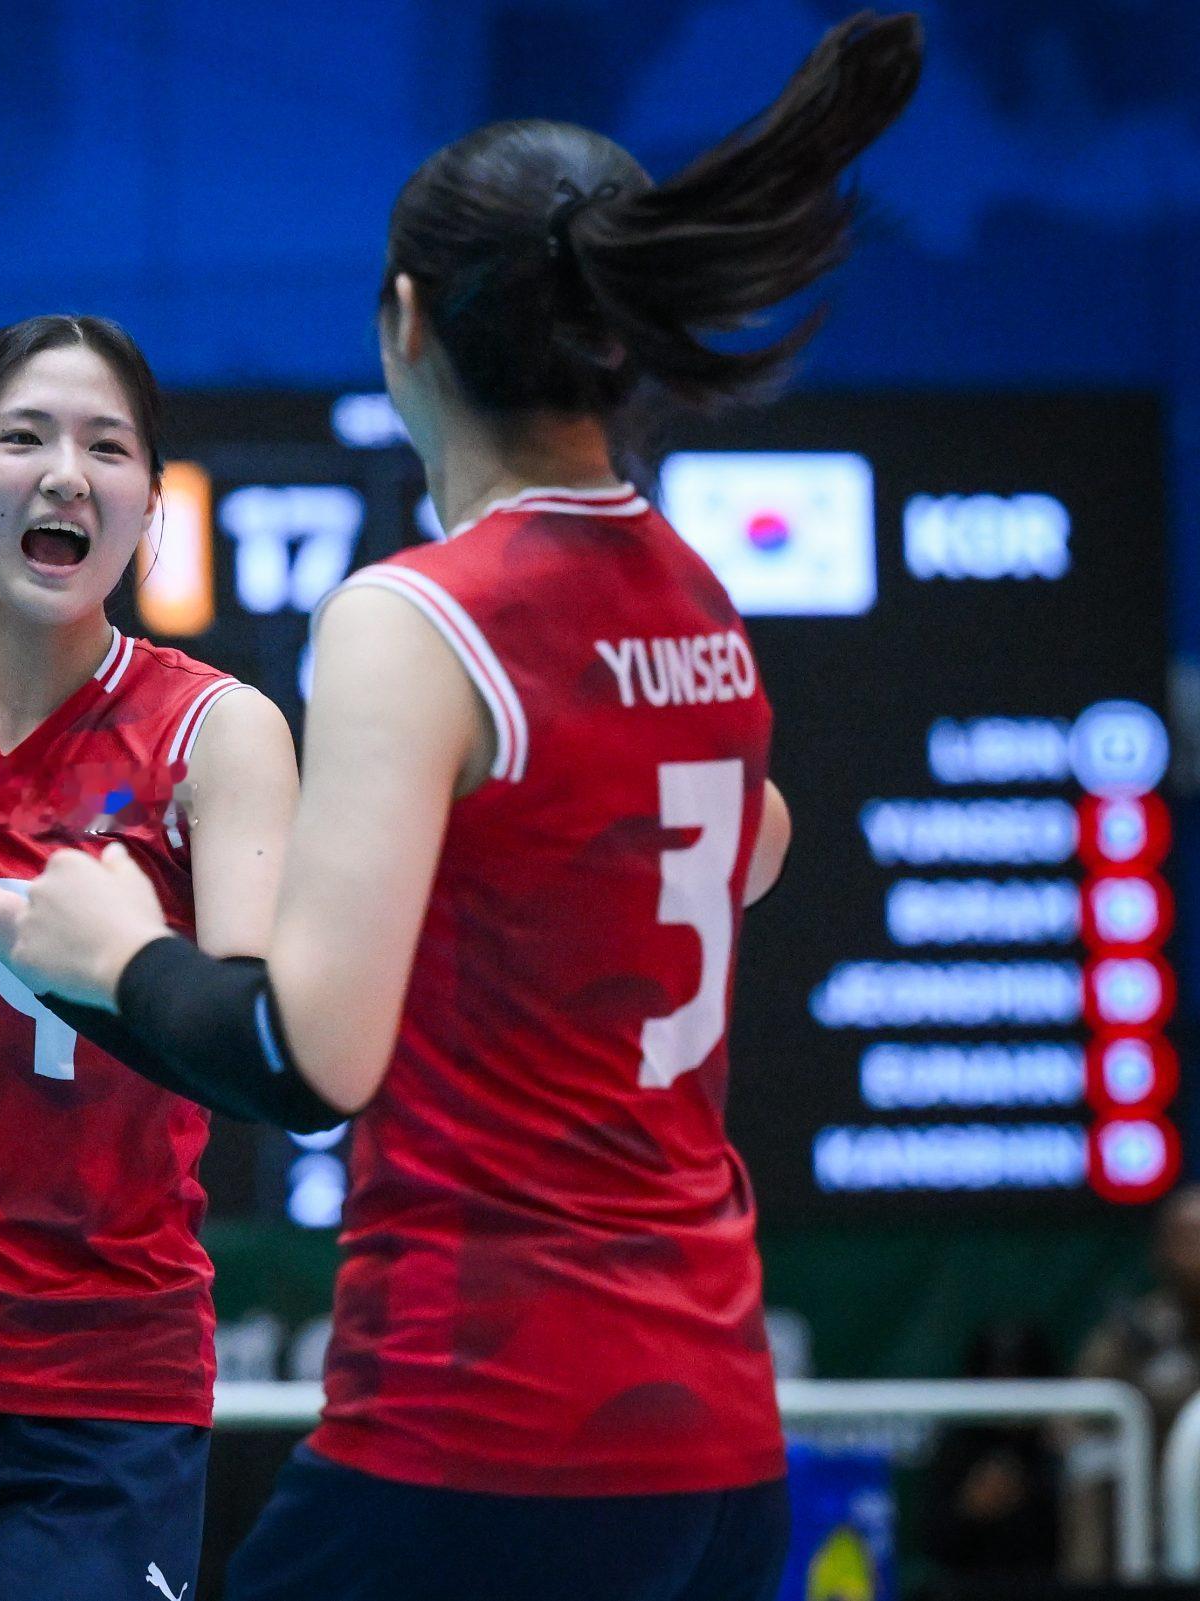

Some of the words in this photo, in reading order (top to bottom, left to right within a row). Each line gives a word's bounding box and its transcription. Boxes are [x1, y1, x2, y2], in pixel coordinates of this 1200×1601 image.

[219, 484, 365, 614] 17
[903, 492, 1071, 580] KOR
[594, 629, 755, 708] YUNSEO
[638, 758, 744, 1089] 3
